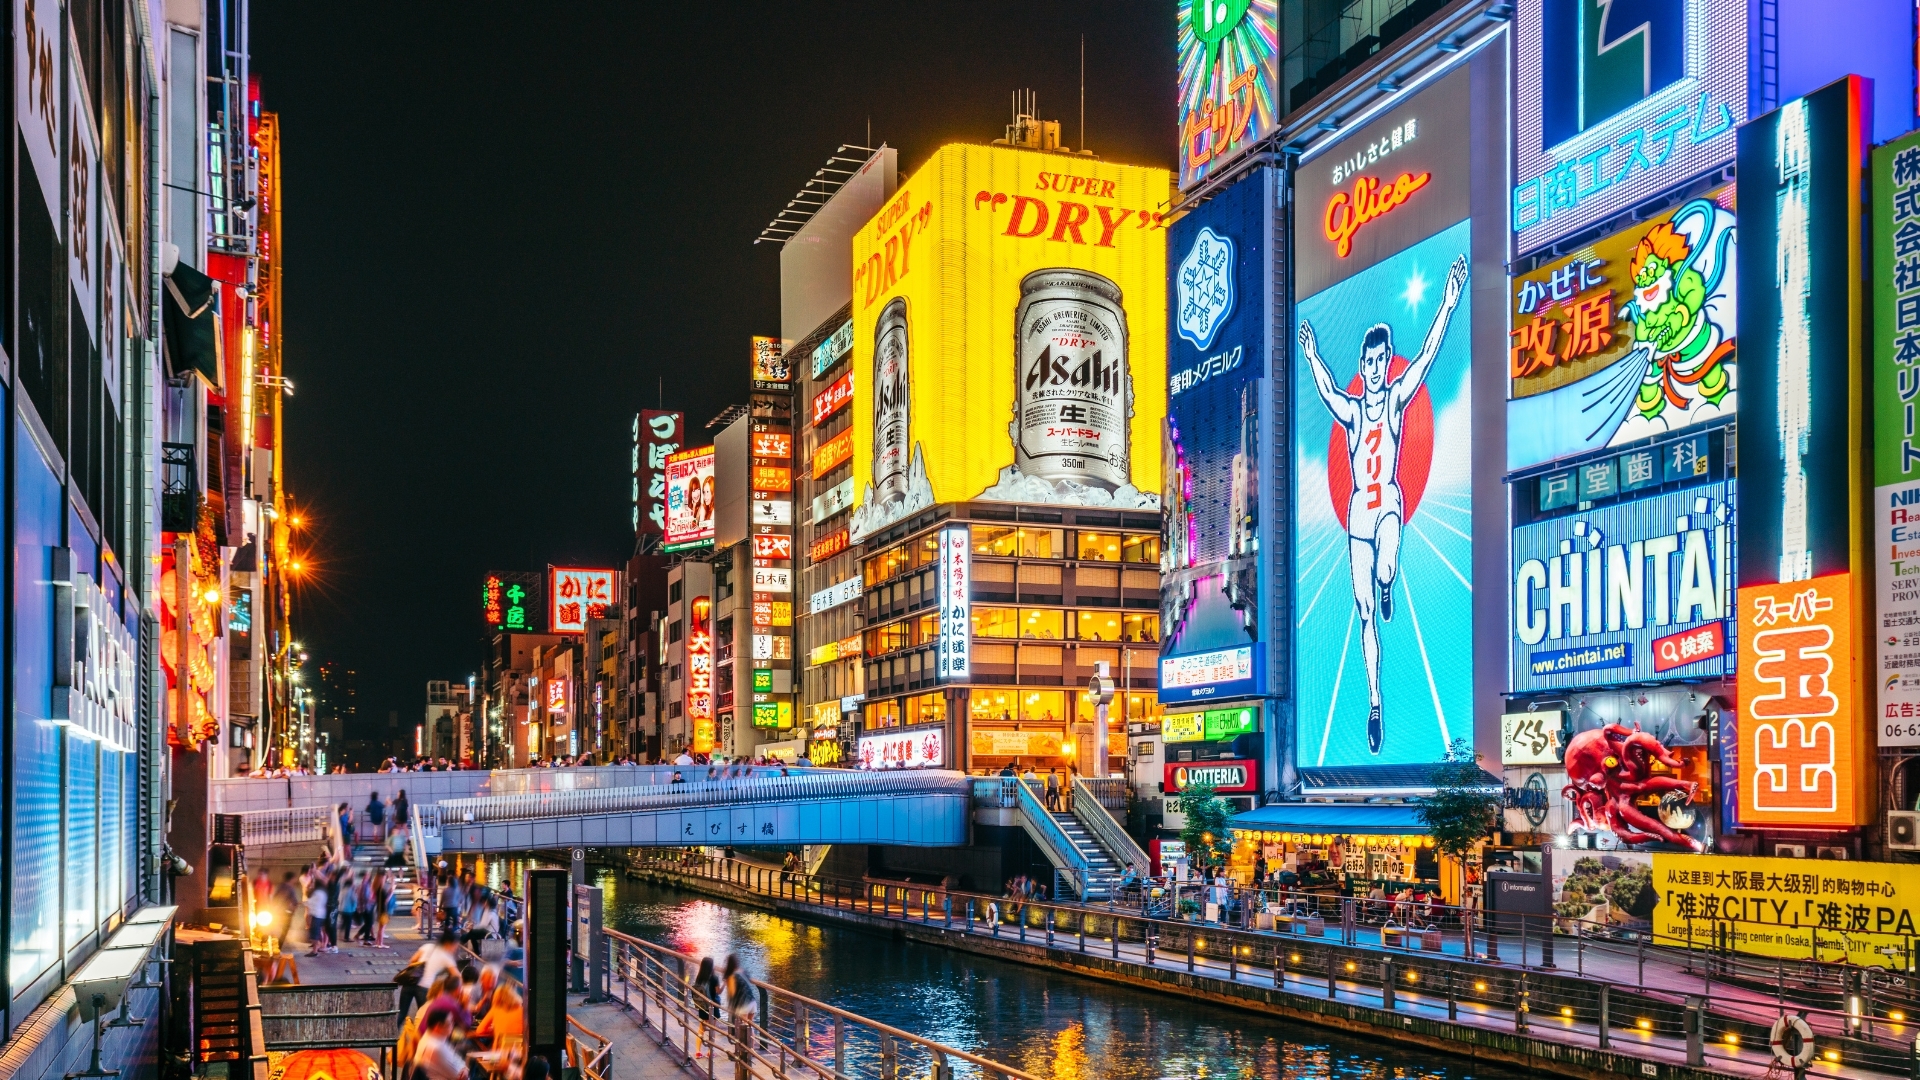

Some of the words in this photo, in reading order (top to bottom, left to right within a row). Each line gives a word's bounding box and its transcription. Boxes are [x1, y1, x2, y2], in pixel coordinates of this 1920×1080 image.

[1188, 64, 1257, 169] ピップ
[1332, 119, 1418, 185] おいしさと健康
[1513, 92, 1732, 232] 日商エステム
[1036, 171, 1116, 198] SUPER
[876, 190, 911, 241] SUPER
[1324, 170, 1431, 258] Glico
[1517, 258, 1603, 314] かぜに
[1036, 317, 1052, 335] ASAHI
[1053, 310, 1088, 322] BREWERIES
[1090, 318, 1109, 341] LIMITED
[1509, 289, 1614, 378] 改源
[1025, 344, 1119, 397] Asahi
[1170, 345, 1243, 396] 雪印メグミルク
[754, 424, 767, 432] 8F
[1059, 404, 1087, 424] 生
[1047, 427, 1101, 440] スーパードライ
[1062, 458, 1085, 469] 350ml
[1365, 422, 1384, 509] グリコ
[1696, 460, 1707, 474] 3F
[754, 559, 768, 567] 4F
[755, 572, 788, 585] 白木屋
[559, 575, 607, 599] かに
[1515, 525, 1731, 646] CHINTAI
[506, 584, 525, 624] 千房
[1753, 588, 1833, 627] スーパー
[1679, 631, 1715, 659] 検索
[688, 631, 710, 718] 大阪王将
[1512, 719, 1549, 756] くくる
[1188, 768, 1240, 785] LOTTERIA
[685, 822, 775, 836] えびす橋
[1374, 859, 1405, 874] 兄貴の店
[1509, 882, 1535, 892] information
[1750, 933, 1773, 943] center
[1776, 933, 1783, 944] in
[1785, 934, 1811, 948] Osaka,
